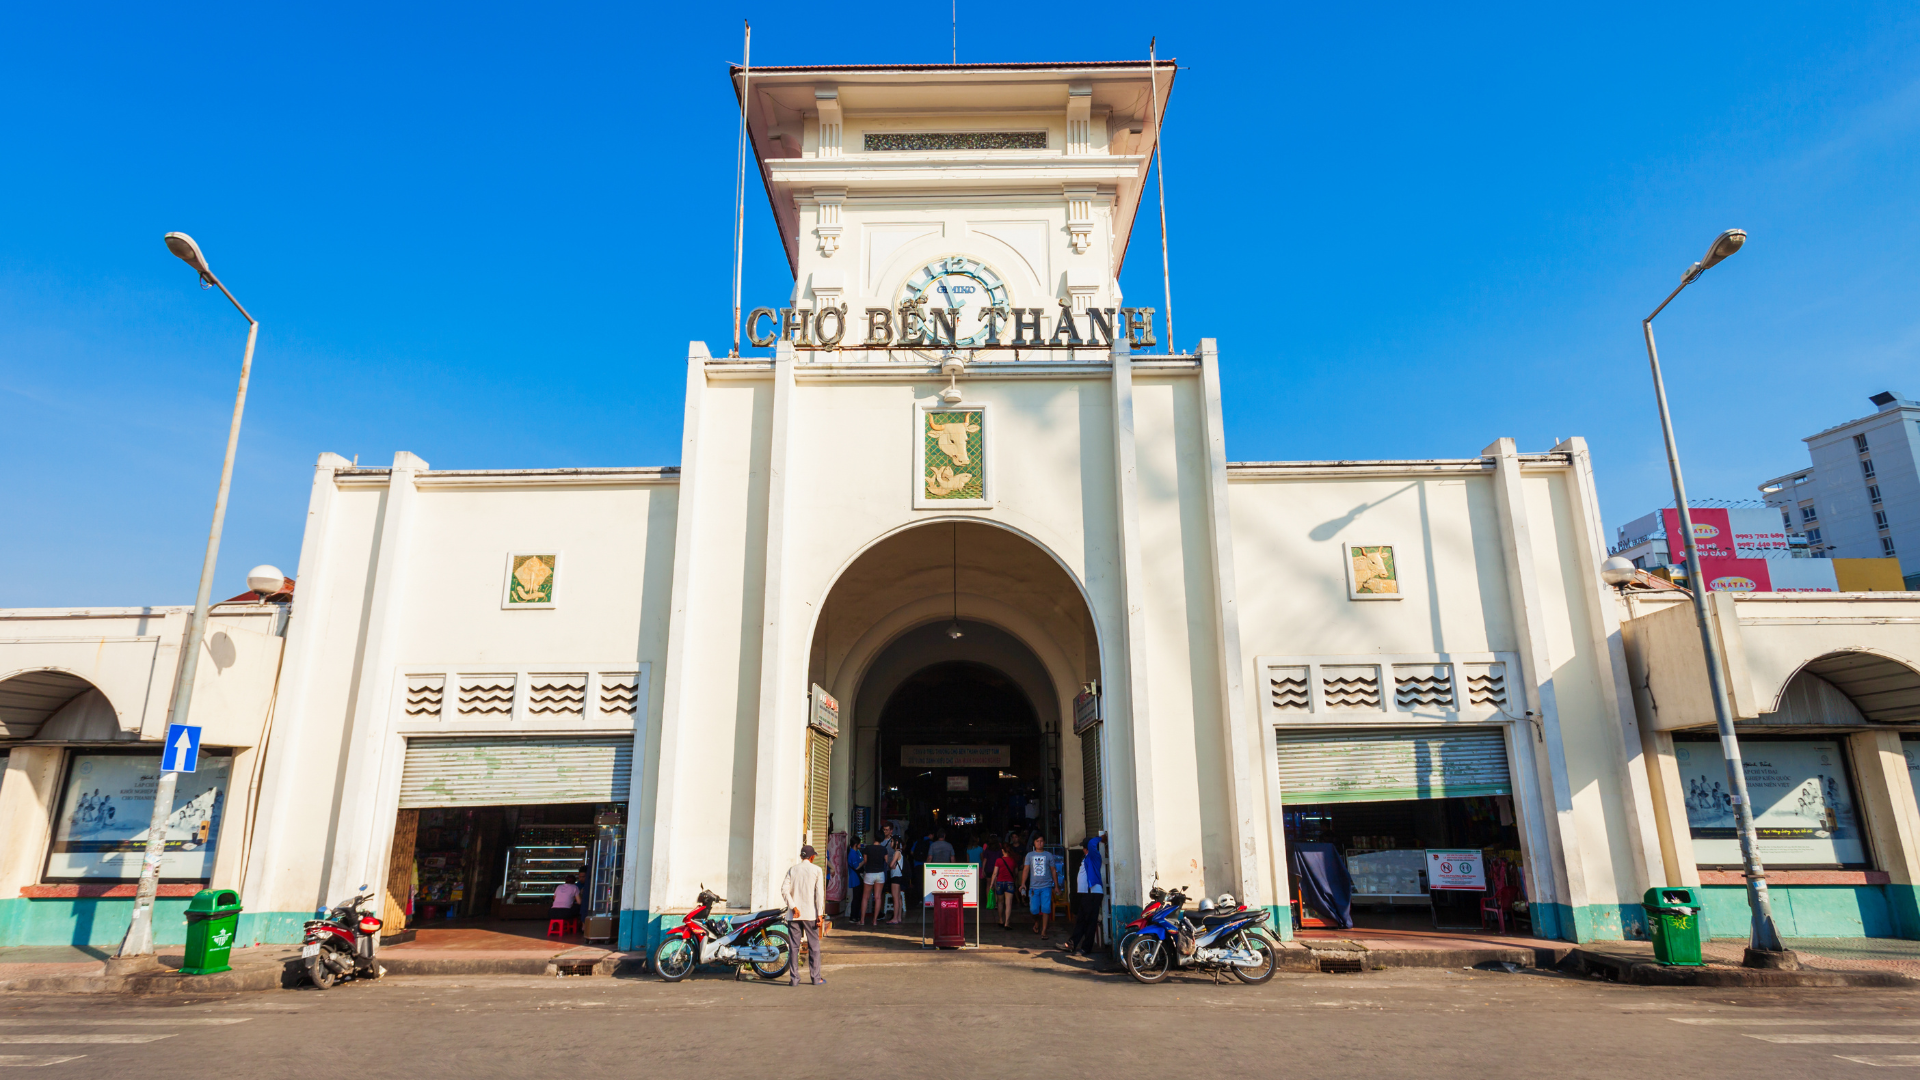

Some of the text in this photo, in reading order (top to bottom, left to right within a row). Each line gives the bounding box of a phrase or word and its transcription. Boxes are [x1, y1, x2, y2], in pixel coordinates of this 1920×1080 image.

[944, 256, 968, 273] 12
[746, 294, 1156, 352] CHỢ BẾN THÀNH
